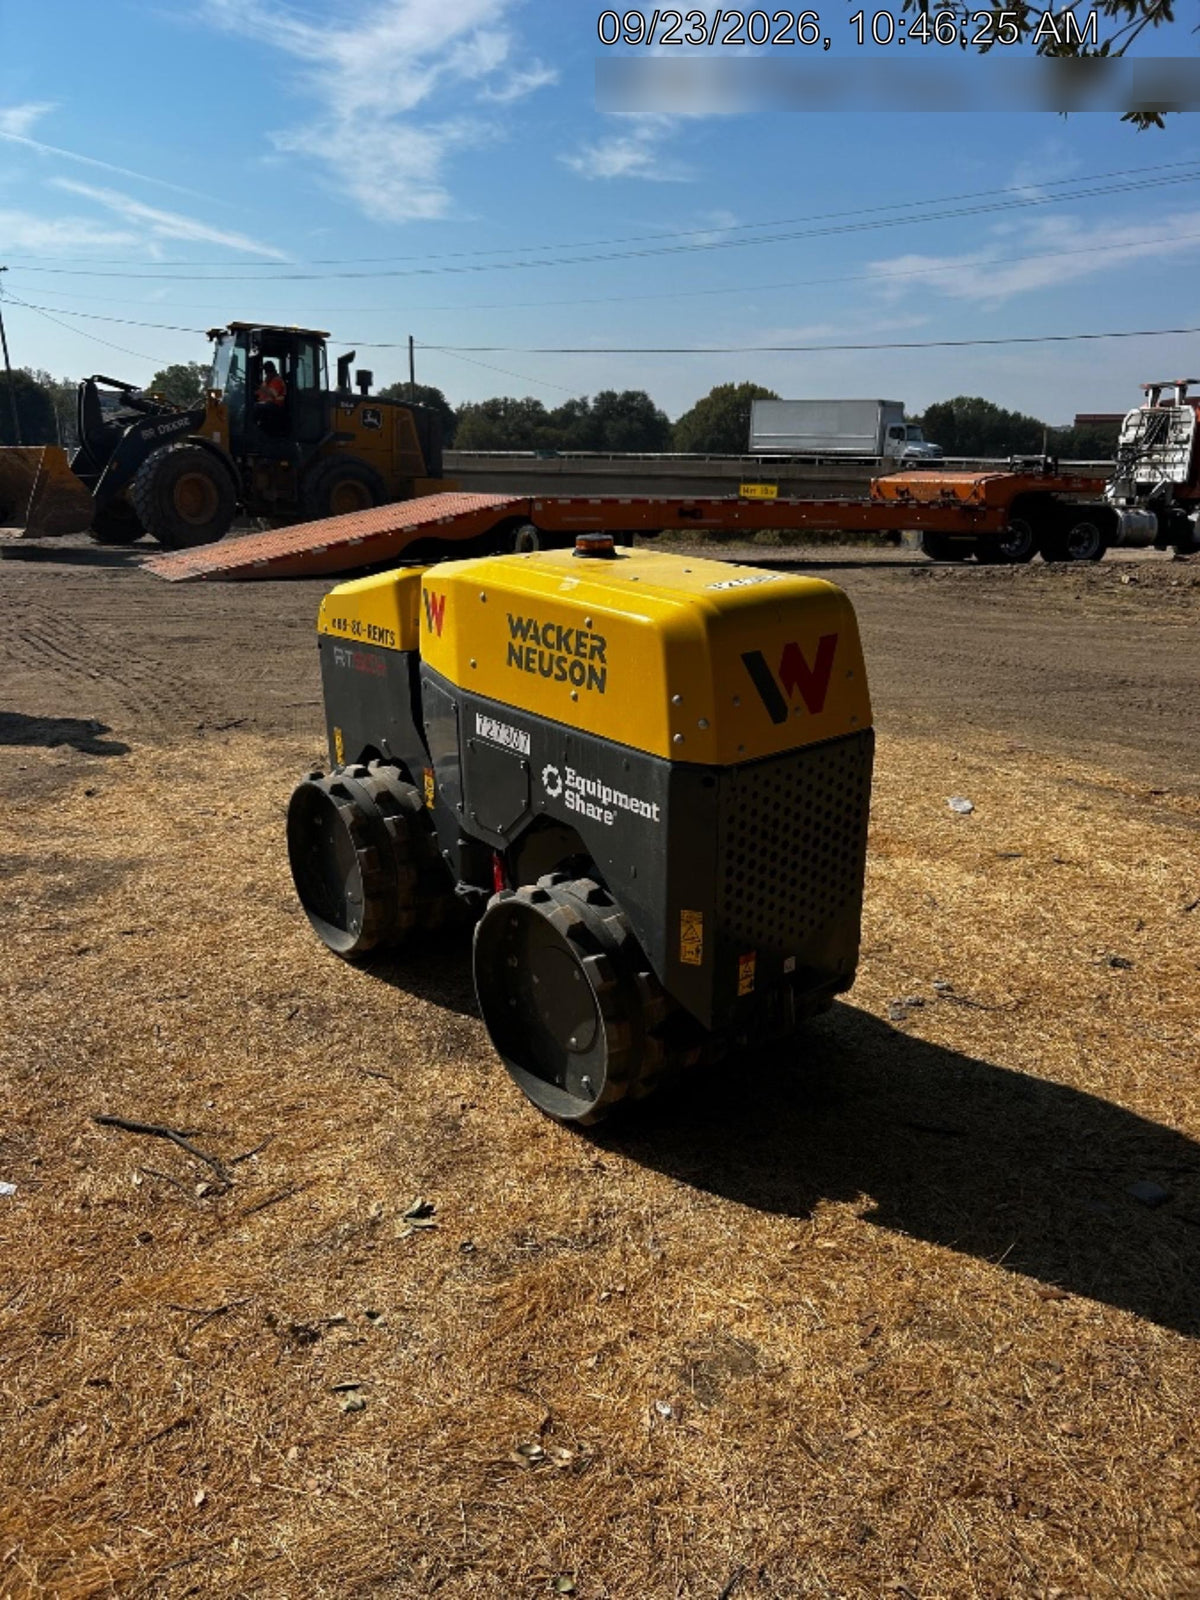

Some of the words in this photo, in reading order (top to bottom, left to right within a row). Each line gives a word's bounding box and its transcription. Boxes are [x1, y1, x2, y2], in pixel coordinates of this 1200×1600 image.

[507, 612, 607, 663] WACKER
[507, 642, 607, 694] NEUSON
[565, 765, 661, 823] Equipment
